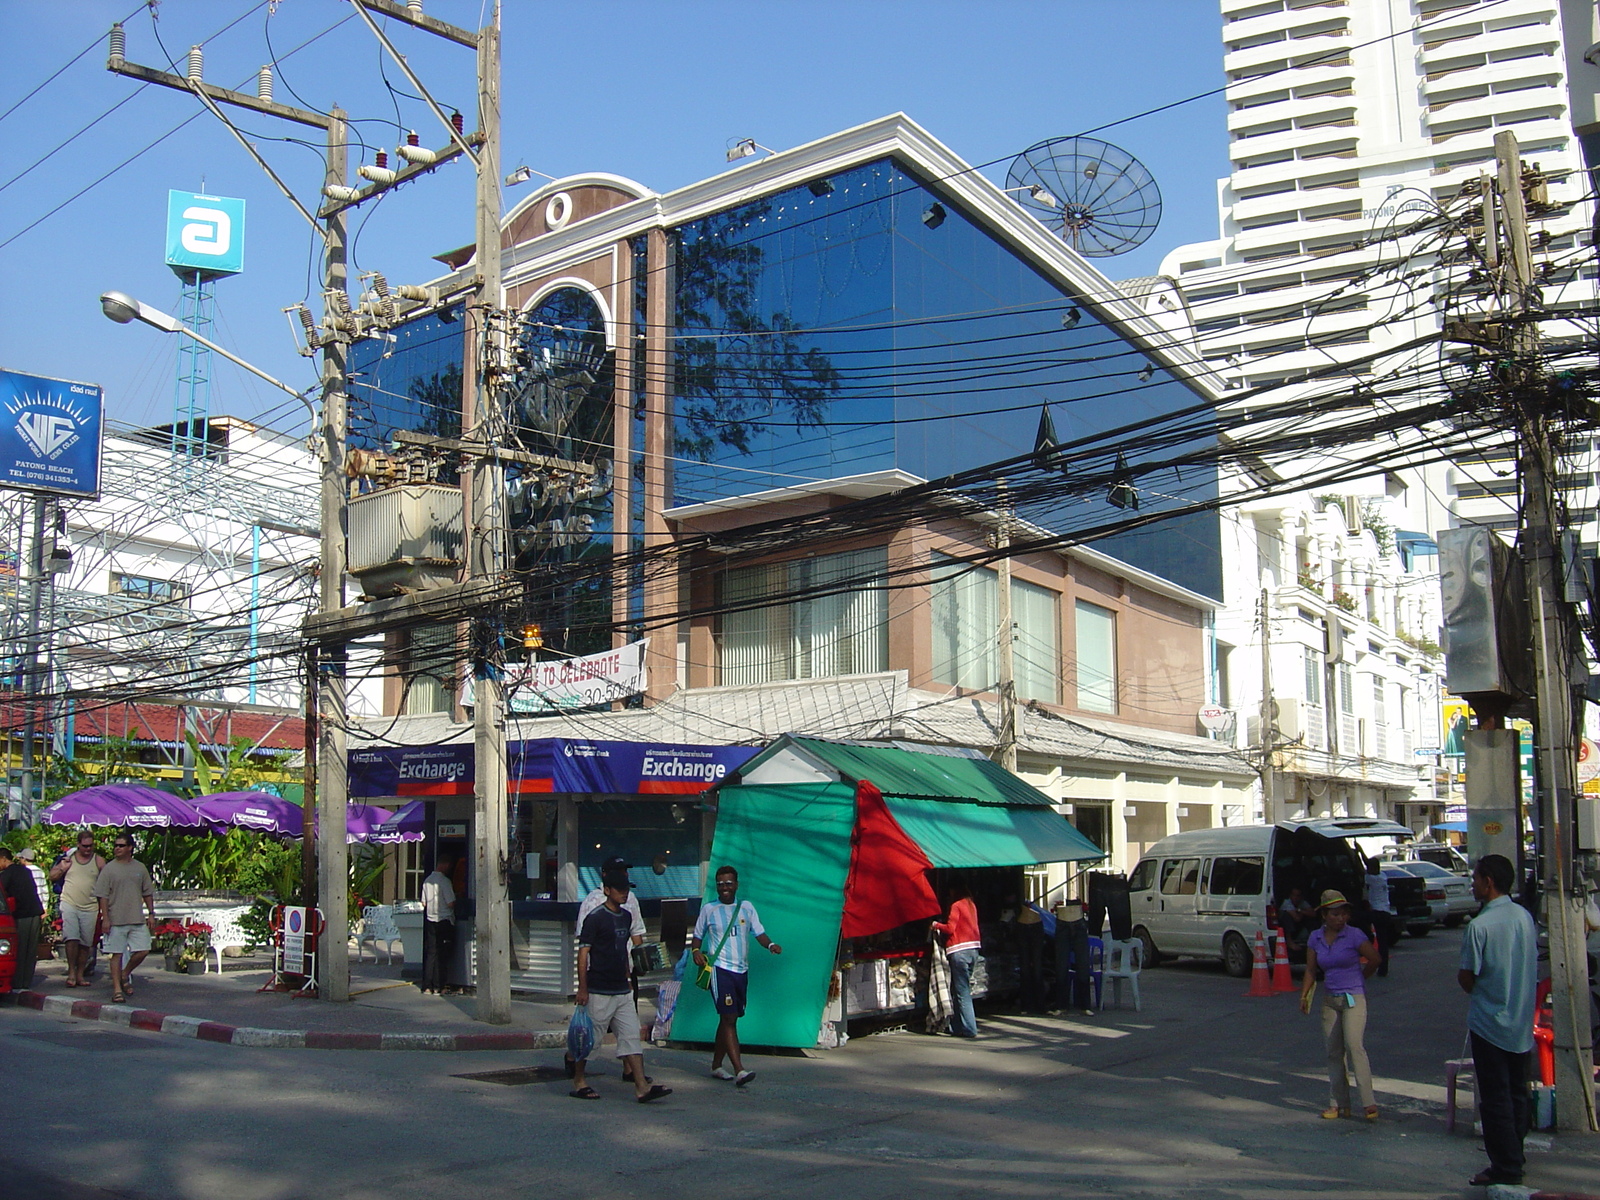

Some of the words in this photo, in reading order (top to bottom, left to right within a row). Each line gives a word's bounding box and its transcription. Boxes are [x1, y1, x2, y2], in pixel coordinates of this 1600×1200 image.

[1363, 206, 1395, 220] PATONG
[28, 440, 42, 459] WORLD
[49, 447, 64, 461] GEMS
[8, 469, 26, 477] TEL.
[26, 471, 44, 480] (076)
[15, 460, 46, 470] PATONG
[48, 464, 74, 475] BEACH
[543, 666, 556, 687] TO
[560, 653, 620, 684] CELEBRATE
[399, 759, 466, 782] Exchange
[641, 757, 726, 783] Exchange
